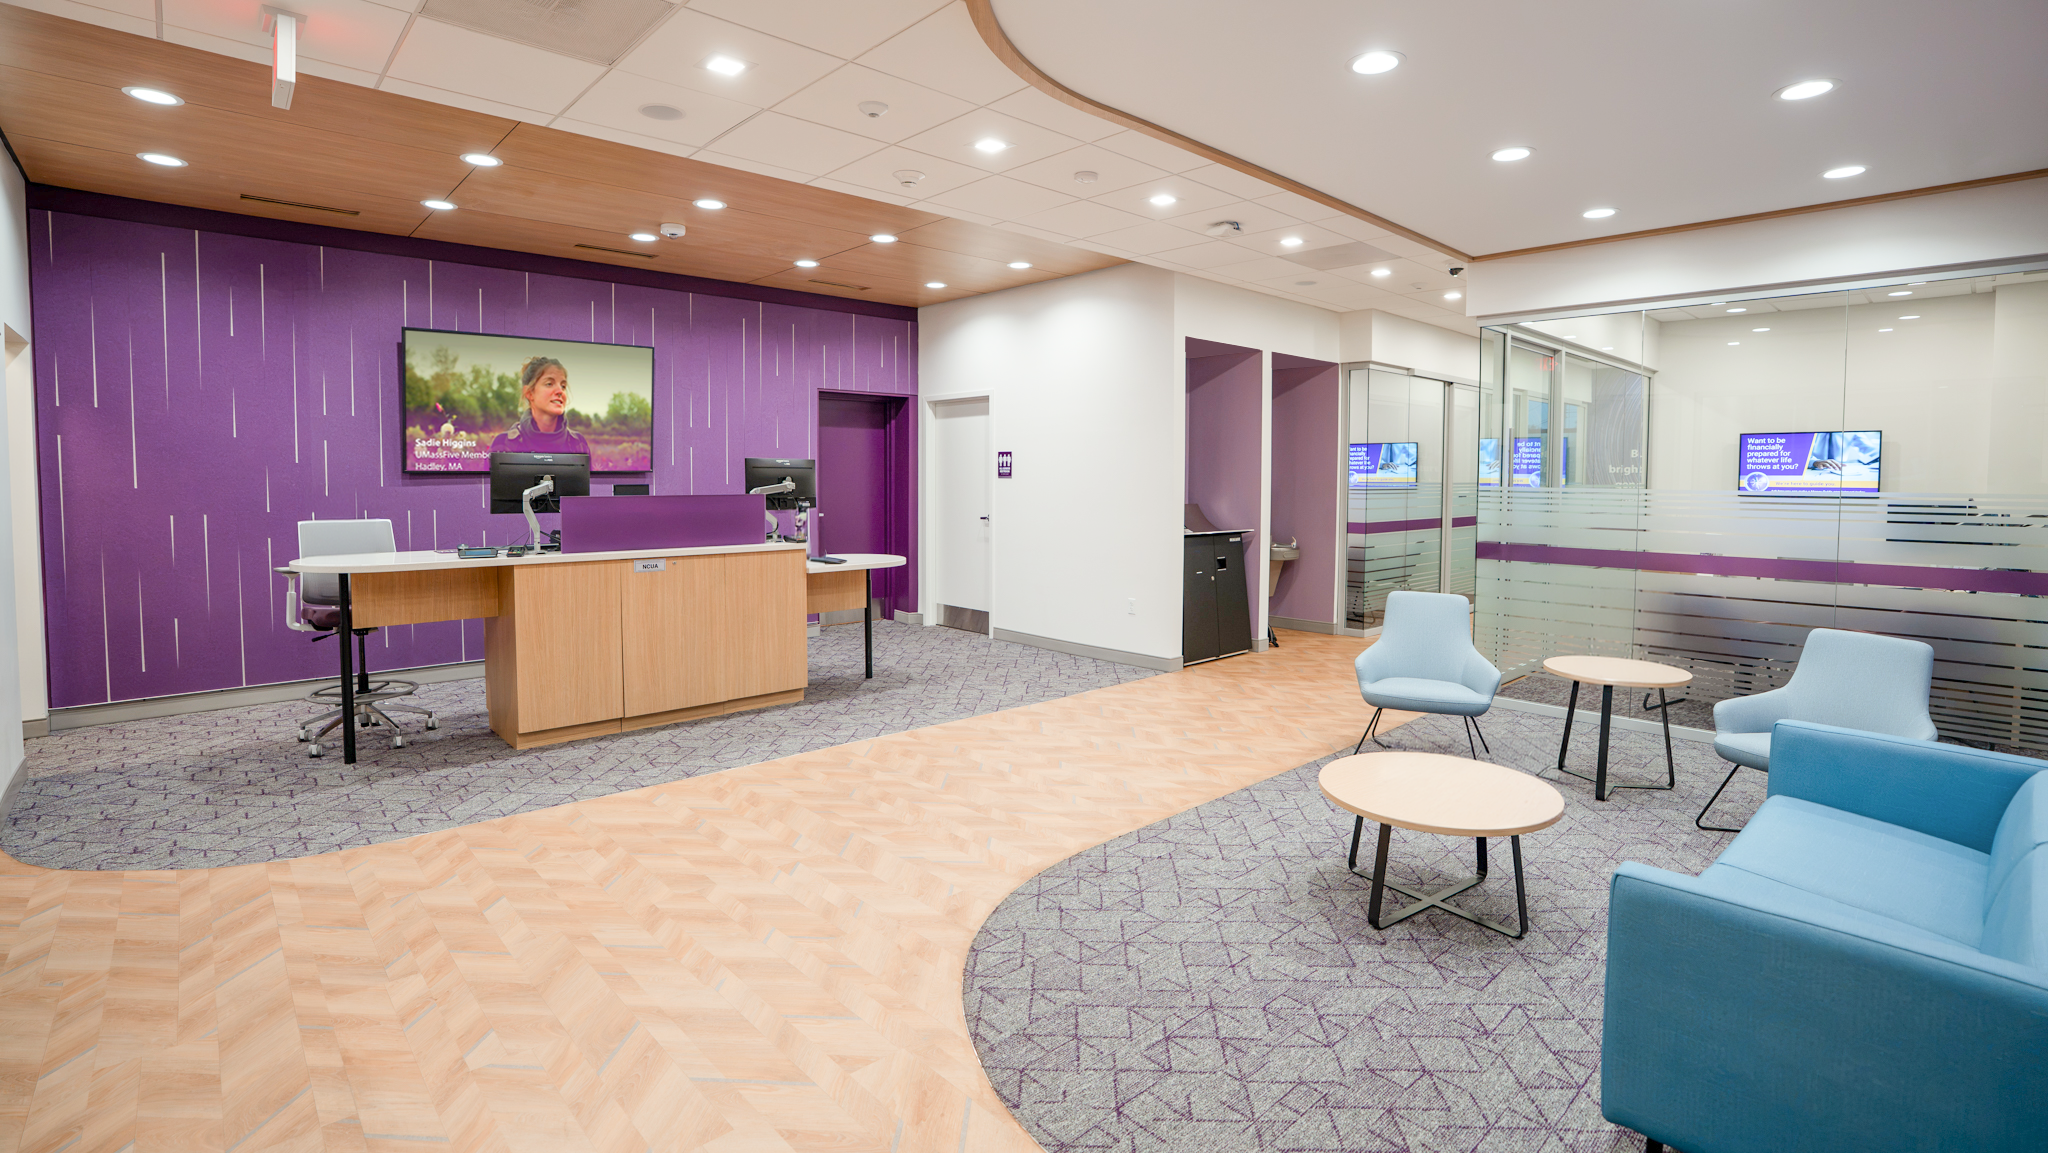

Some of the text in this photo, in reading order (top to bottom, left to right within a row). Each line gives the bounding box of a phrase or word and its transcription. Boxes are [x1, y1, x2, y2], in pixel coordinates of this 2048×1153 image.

[415, 438, 476, 449] Sadie Higgins
[414, 451, 491, 459] UMassFive Membe
[415, 463, 447, 471] Hadley,
[1781, 463, 1798, 471] you?
